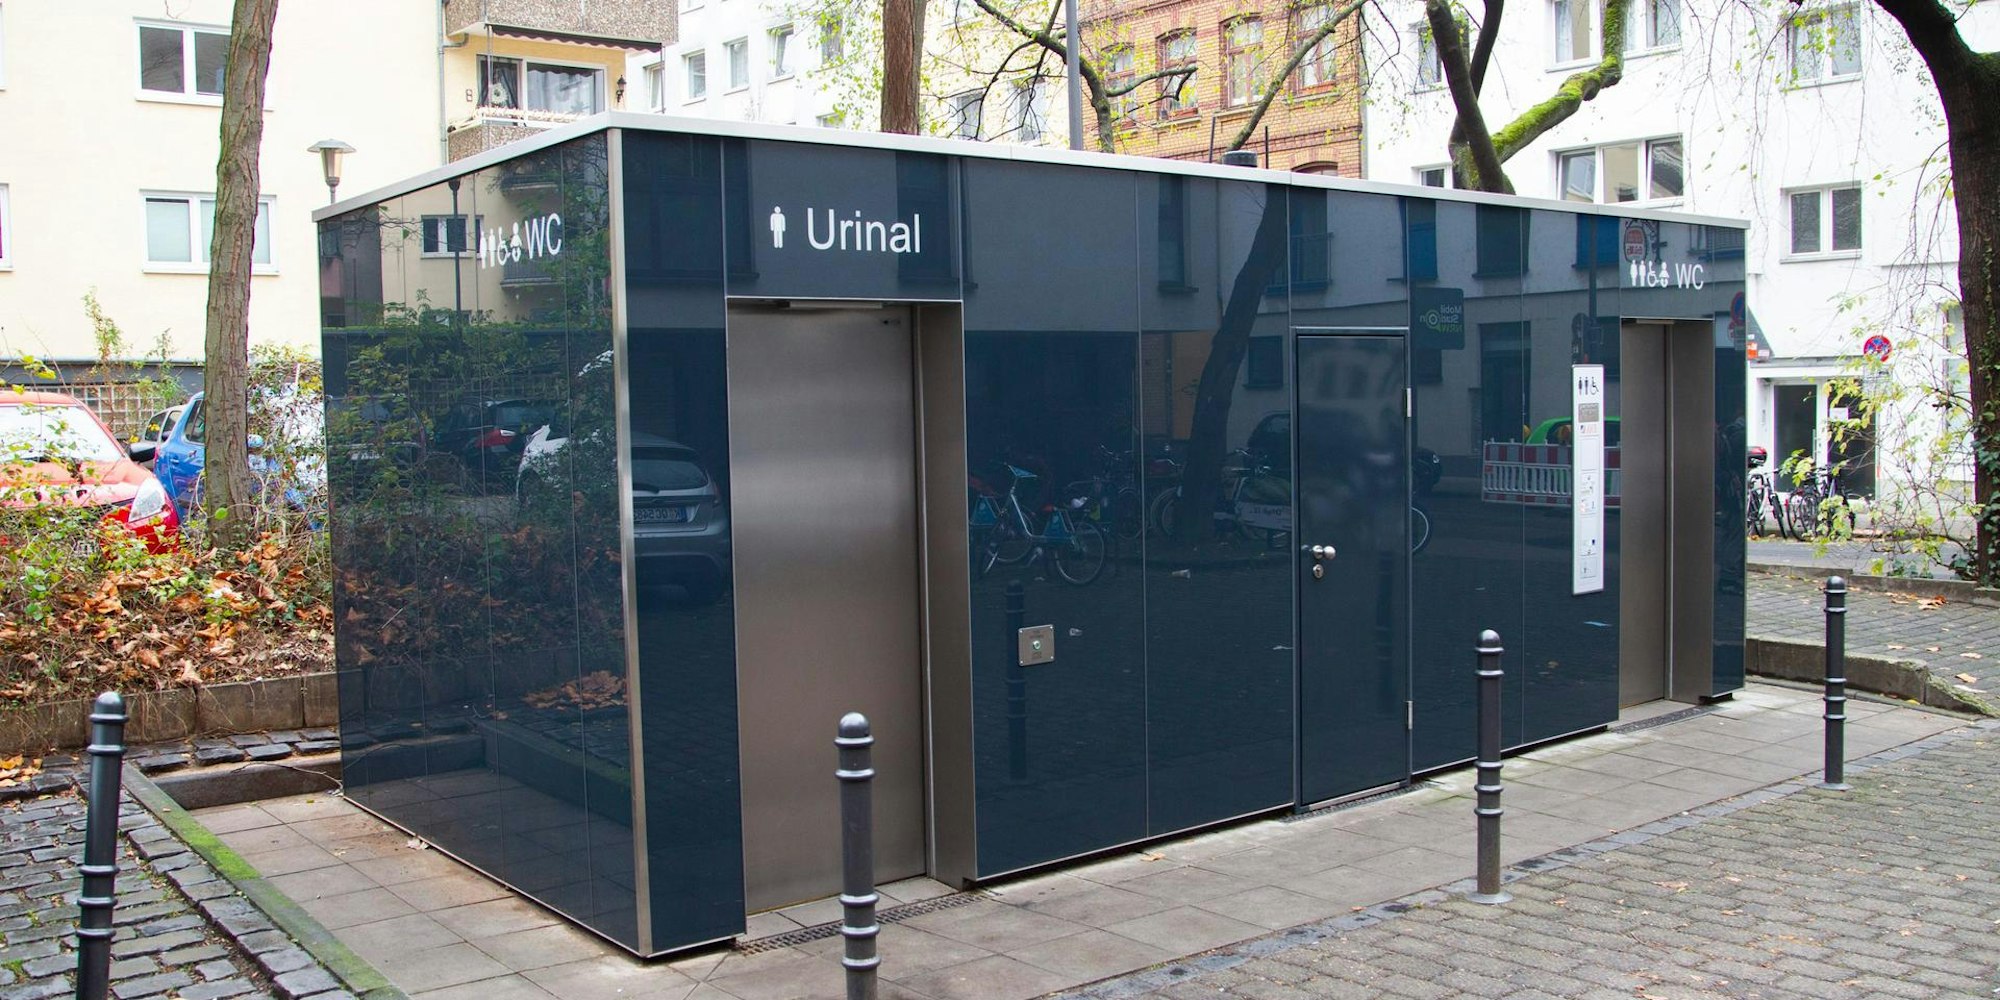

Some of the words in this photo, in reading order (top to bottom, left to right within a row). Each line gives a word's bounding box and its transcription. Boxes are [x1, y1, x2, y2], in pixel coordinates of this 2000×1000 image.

[525, 212, 562, 259] WC
[807, 207, 921, 253] Urinal
[1675, 263, 1704, 290] WC
